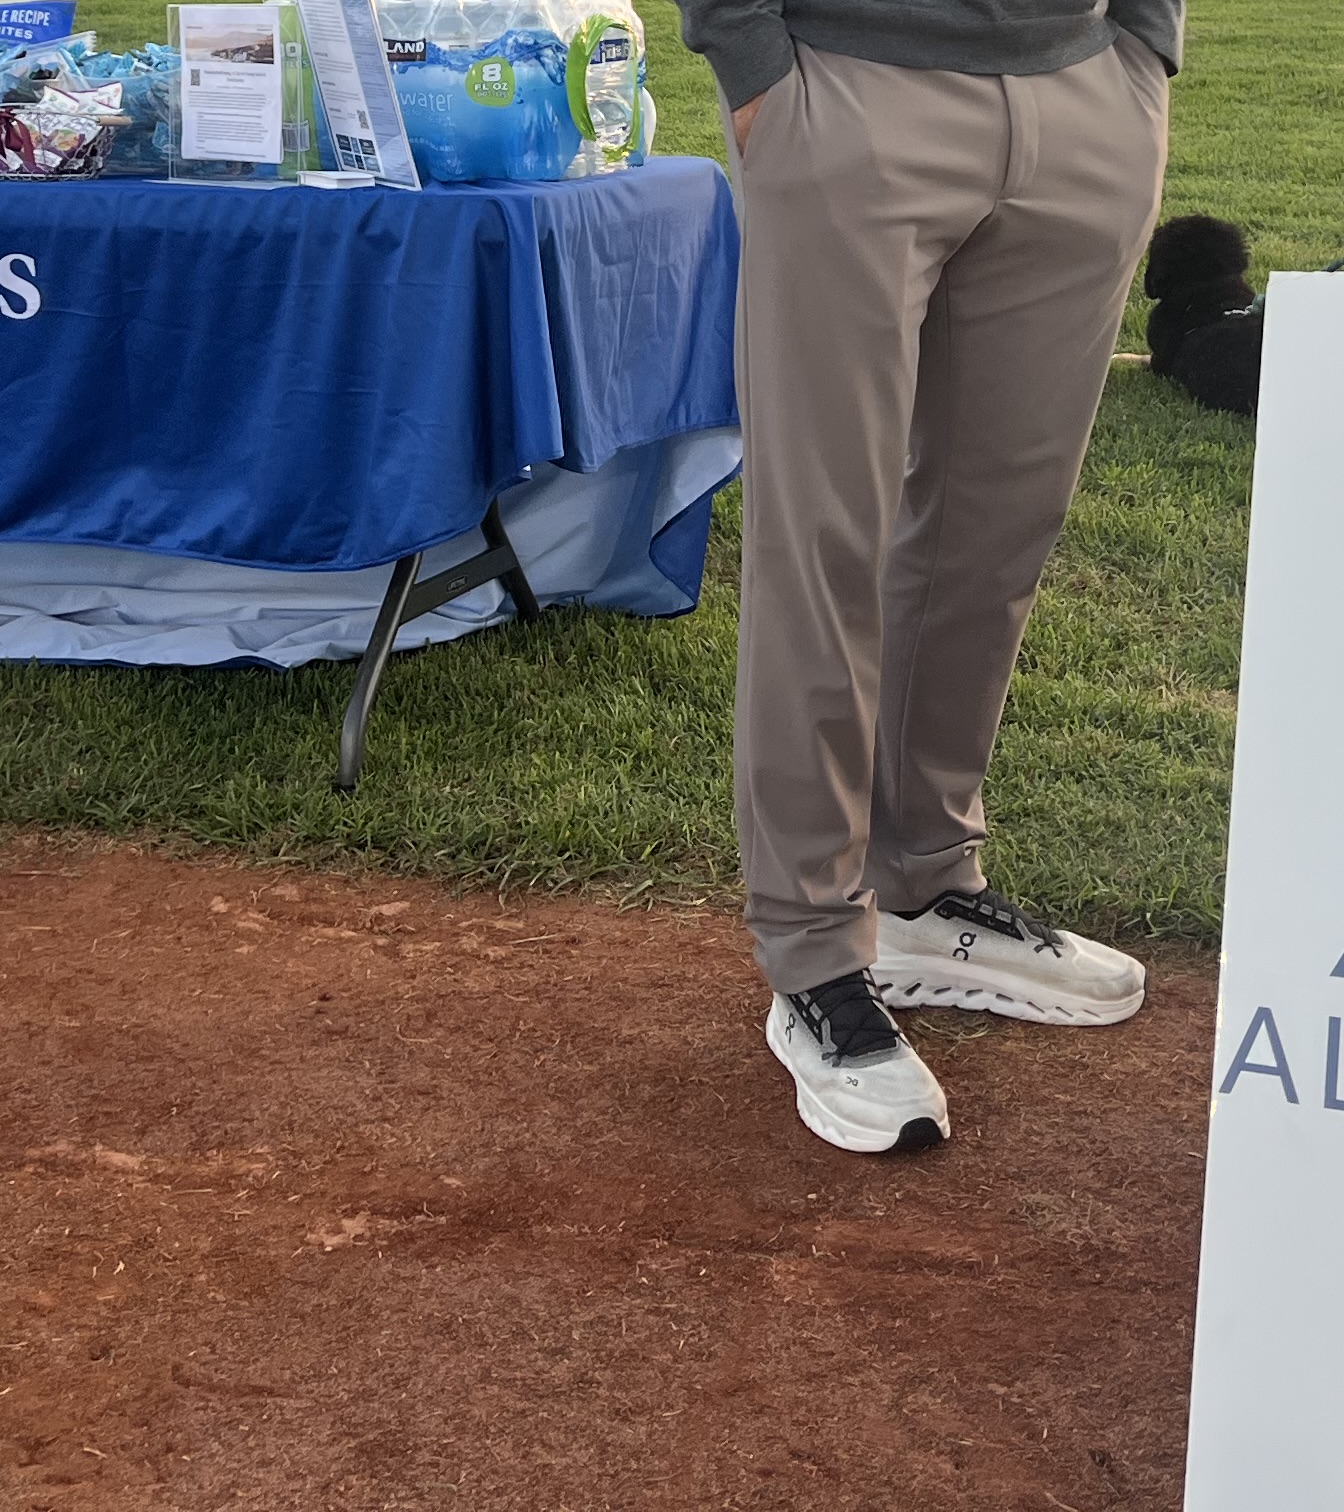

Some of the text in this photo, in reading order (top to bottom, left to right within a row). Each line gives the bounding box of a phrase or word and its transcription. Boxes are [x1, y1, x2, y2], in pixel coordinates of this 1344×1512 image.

[10, 9, 51, 27] RECIPE
[385, 41, 425, 54] LAND
[482, 63, 502, 82] 8
[474, 82, 509, 91] FL OZ
[399, 92, 454, 112] water
